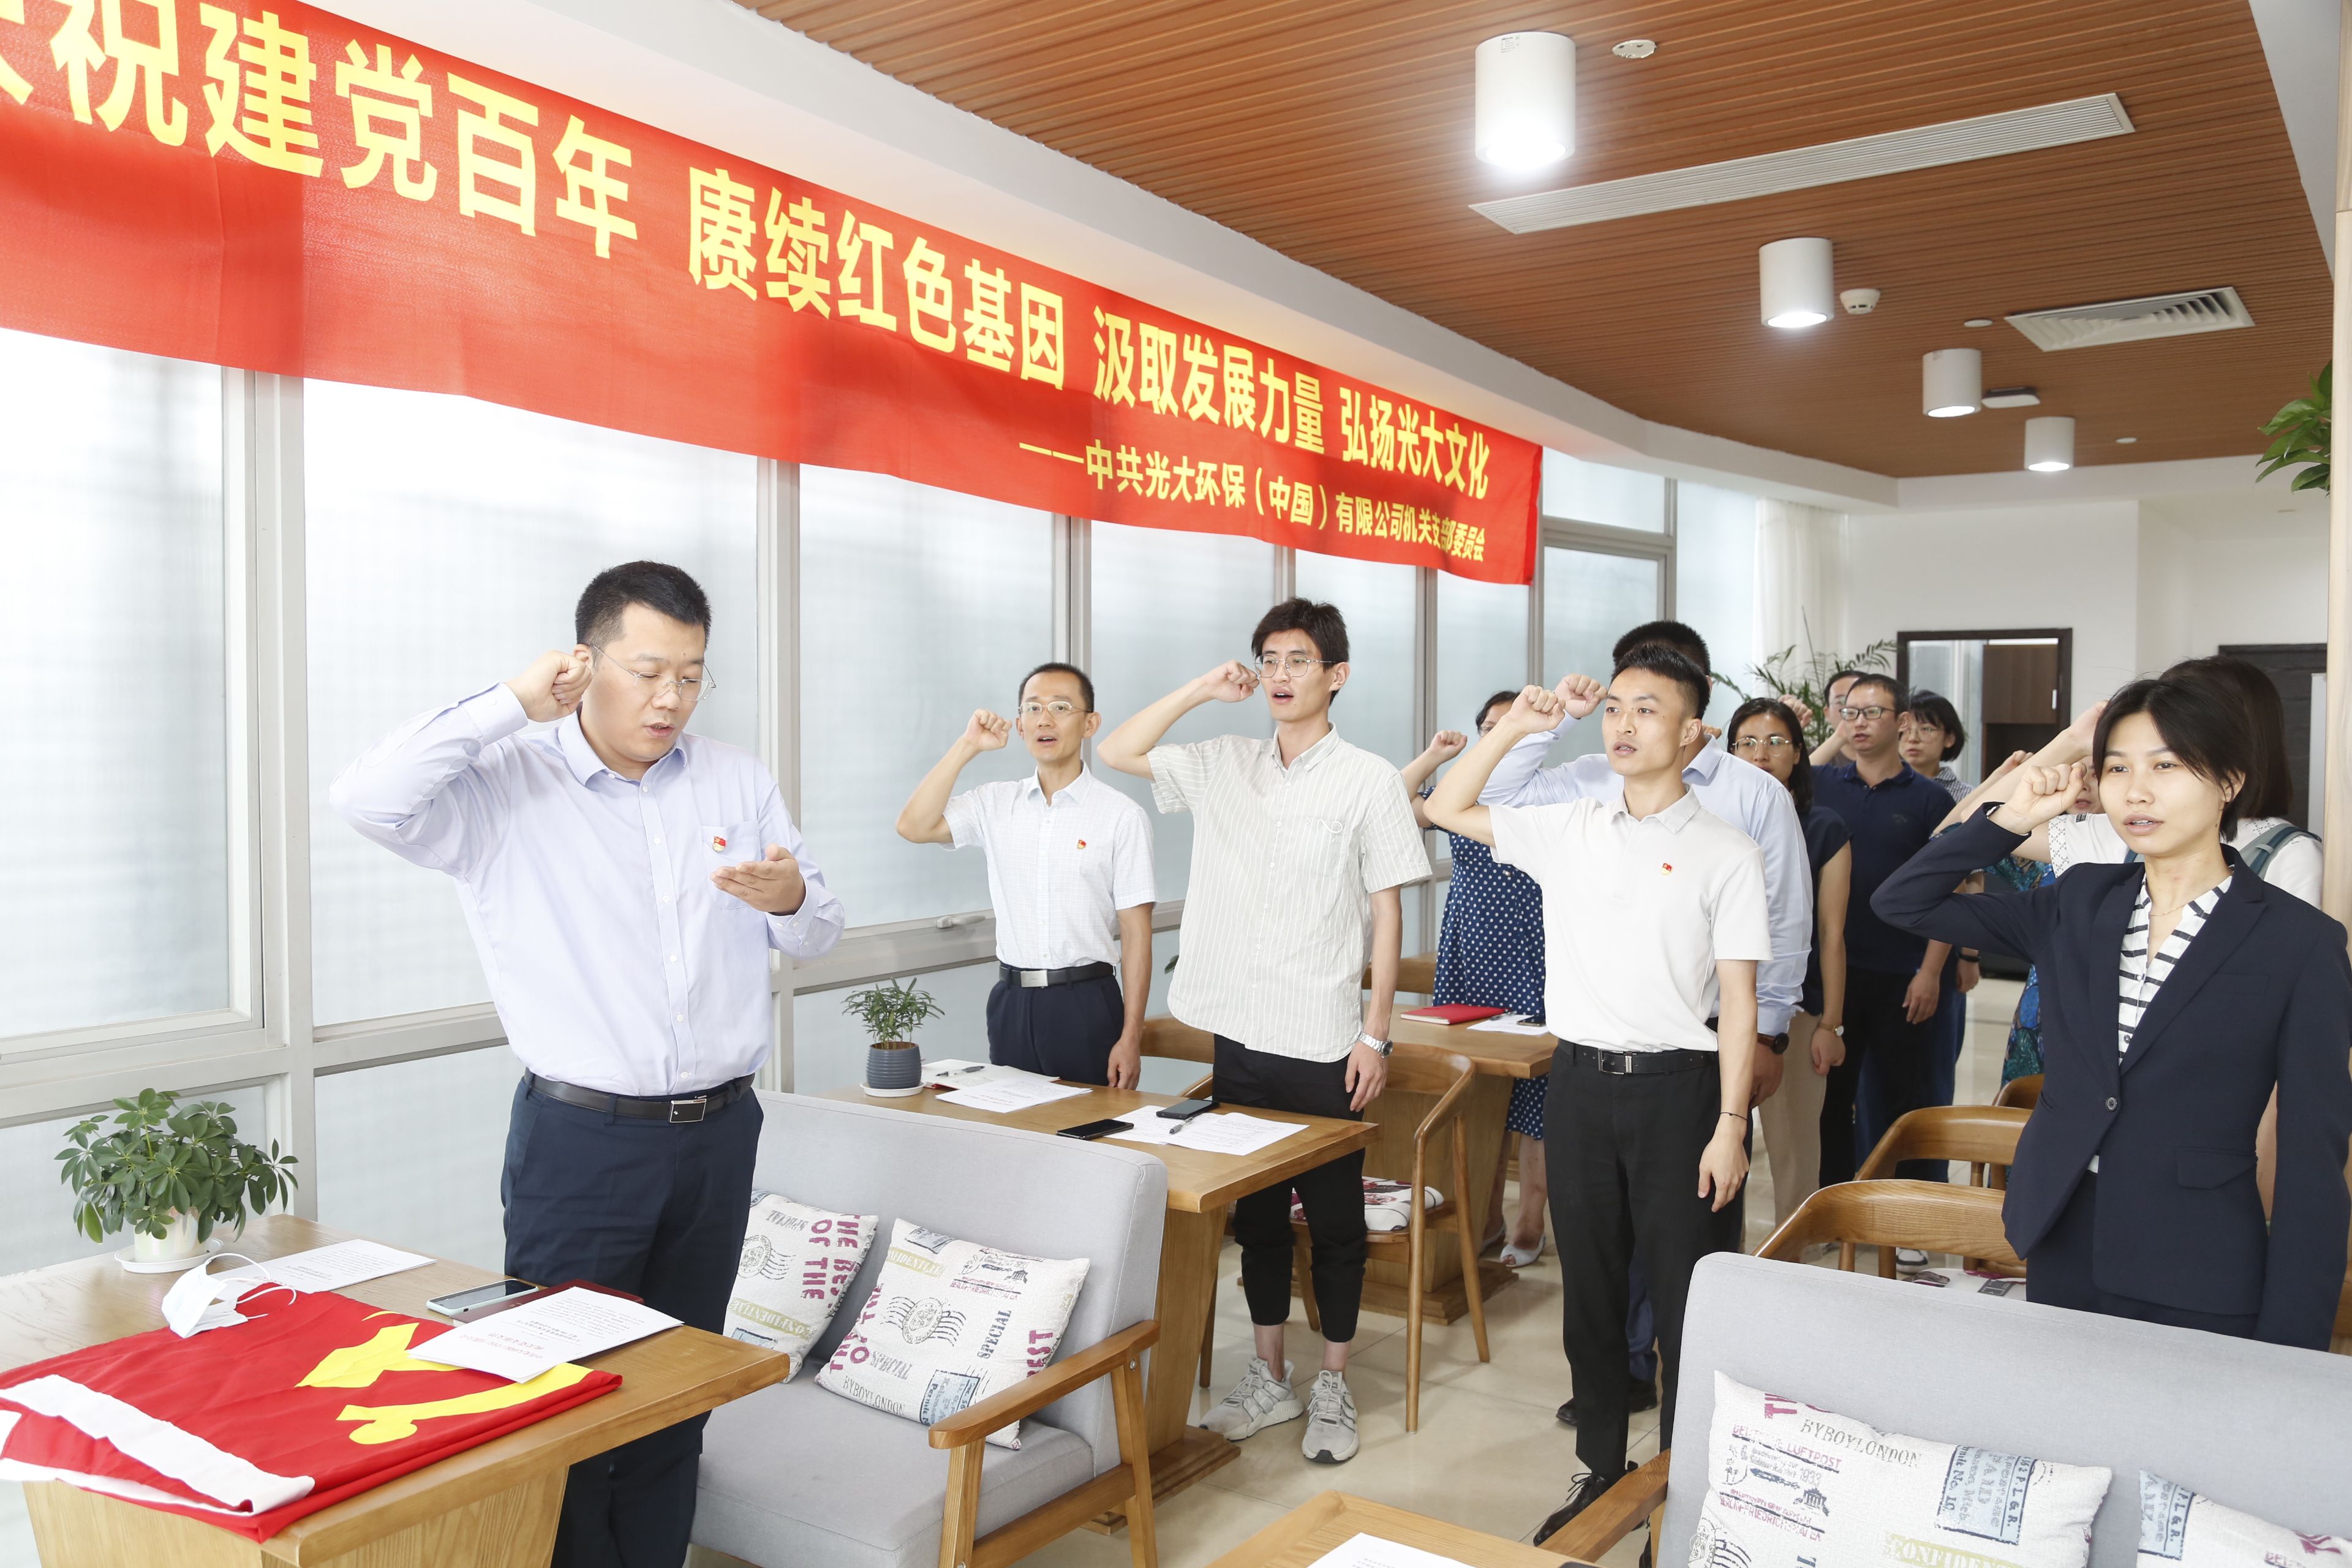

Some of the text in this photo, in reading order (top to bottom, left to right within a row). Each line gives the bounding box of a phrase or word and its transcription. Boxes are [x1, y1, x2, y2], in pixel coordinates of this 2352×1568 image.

[0, 0, 1490, 500] 祝建党百年 赓续红色基因 汲取发展力量 弘扬光大文化
[801, 1257, 828, 1300] THE
[976, 1310, 1012, 1359] SPECIAL
[842, 1374, 906, 1415] BYBOYLONDON
[1787, 1442, 1843, 1468] LUFTPOST
[1800, 1418, 1922, 1468] BYBOYLONDON
